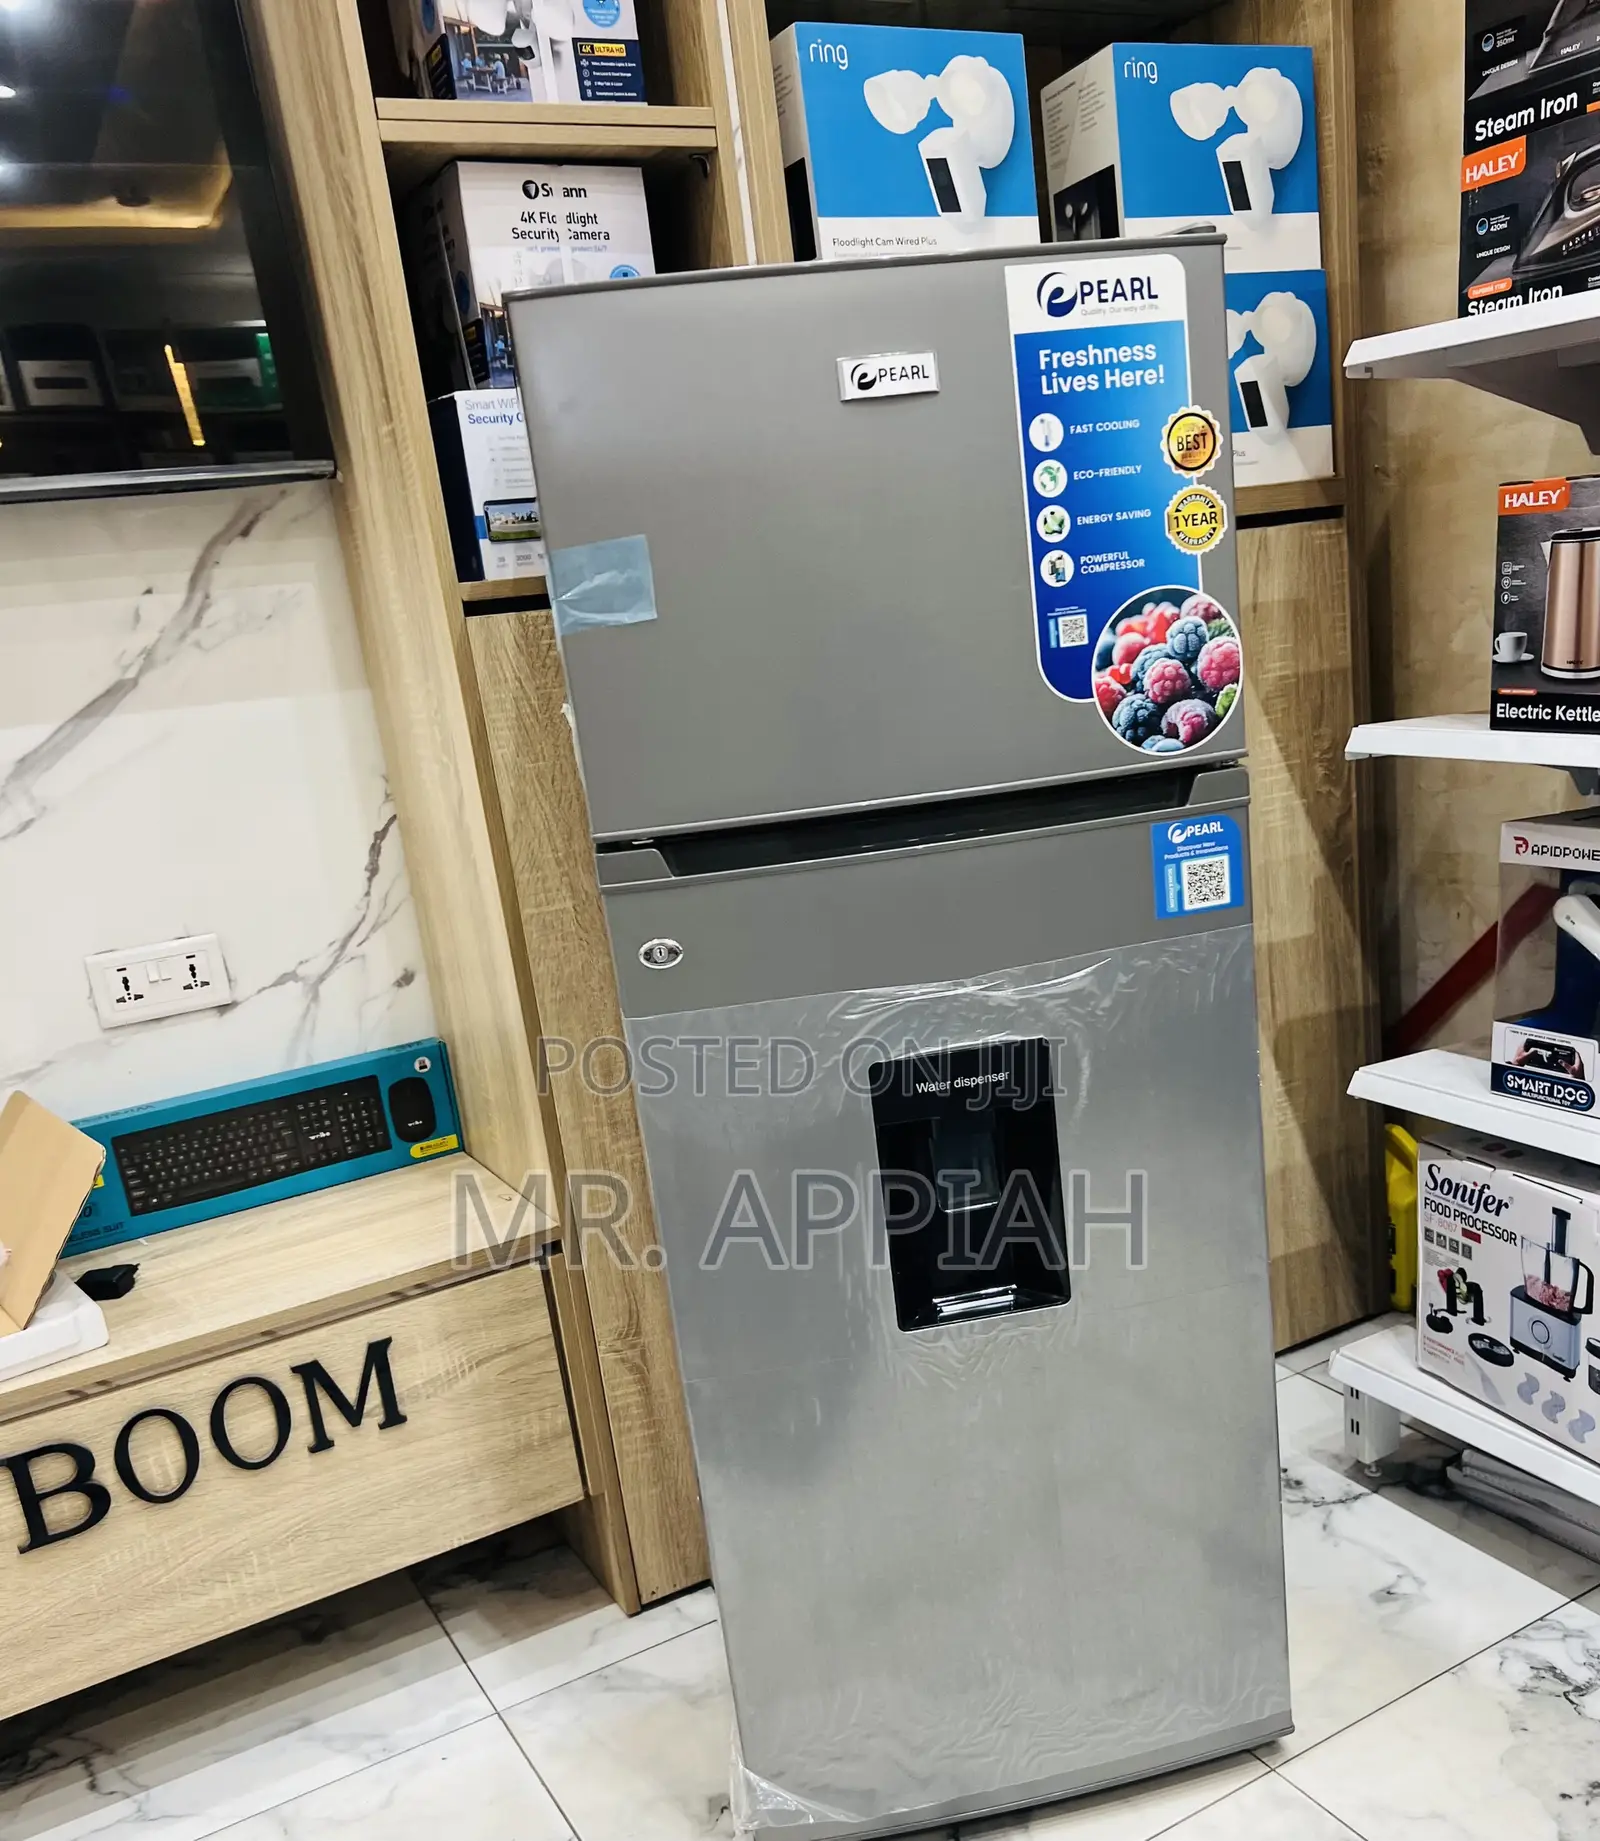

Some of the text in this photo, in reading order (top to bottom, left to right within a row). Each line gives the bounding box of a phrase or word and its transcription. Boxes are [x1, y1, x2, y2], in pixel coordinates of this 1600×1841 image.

[581, 44, 593, 54] 4K
[809, 39, 848, 70] ring
[1560, 41, 1581, 55] HALEY
[1123, 56, 1158, 84] ring
[1474, 91, 1579, 142] Steam Iron
[1465, 151, 1520, 184] HALEY
[541, 182, 588, 199] Sann
[520, 211, 599, 228] 4K Flodlight
[511, 227, 560, 243] Security
[832, 236, 938, 248] Floodlight Cam Wired Plus
[1476, 244, 1511, 259] UNIQUE DESIGN
[1467, 294, 1523, 317] Steam
[1528, 284, 1563, 304] Iron
[1038, 344, 1157, 371] Freshness
[1041, 364, 1165, 395] Lives Here!
[464, 399, 496, 411] Smart
[467, 411, 514, 425] Security
[1069, 419, 1140, 434] FAST COOLING
[1176, 432, 1208, 451] BEST
[1073, 465, 1142, 480] ECO-FRIENDLY
[1176, 494, 1214, 512] WARRANTY
[1504, 489, 1561, 509] HALEY
[1077, 508, 1152, 525] ENERGY SAVING
[1173, 511, 1218, 528] 1 YEAR
[1179, 527, 1215, 545] WARRANTY
[1080, 551, 1130, 565] POWERFUL
[1080, 559, 1146, 574] COMPRESSOR
[1496, 703, 1600, 722] Electric Kettle
[1164, 850, 1191, 860] Products
[1195, 845, 1229, 855] Innovations
[1177, 843, 1203, 852] Discover
[916, 1071, 1010, 1093] Water dispenser
[1507, 1074, 1589, 1104] SMART DOG
[1424, 1163, 1510, 1218] Sonifer
[1424, 1196, 1451, 1219] FOOD
[1453, 1208, 1518, 1247] PROCESSOR
[0, 1336, 407, 1554] BOOM
